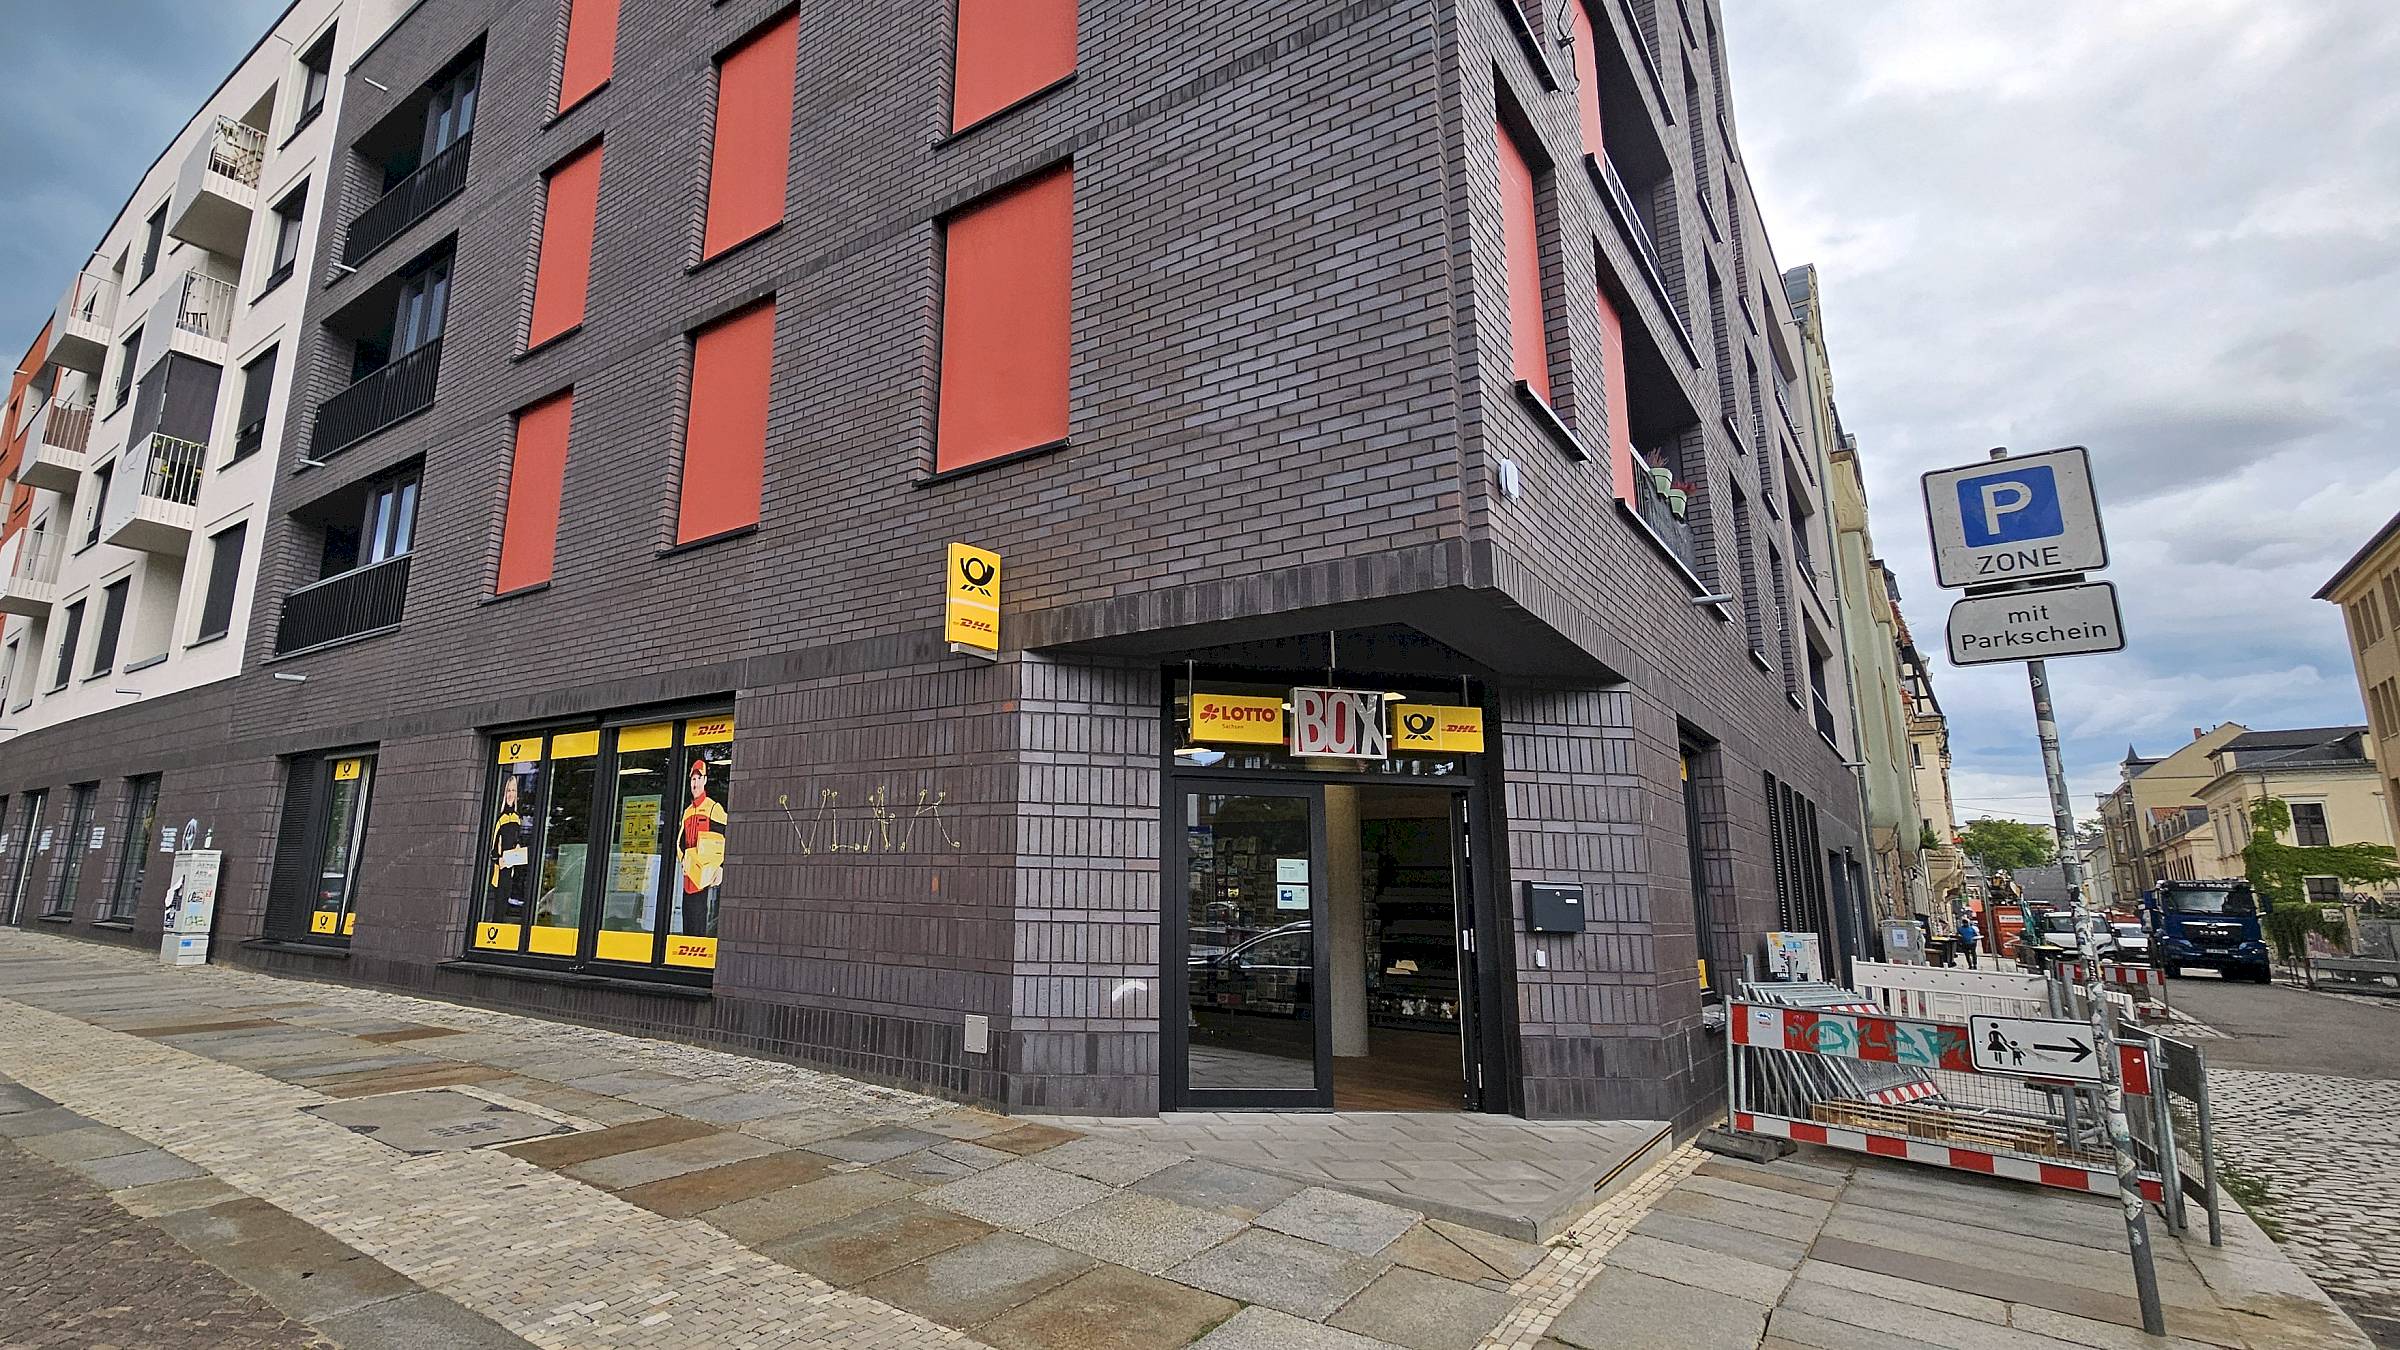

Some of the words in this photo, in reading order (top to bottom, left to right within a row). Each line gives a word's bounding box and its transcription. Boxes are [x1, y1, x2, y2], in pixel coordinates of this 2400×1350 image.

[1980, 481, 2033, 536] P
[1977, 546, 2062, 575] ZONE
[2008, 604, 2050, 624] mit
[959, 617, 993, 634] DHL
[1961, 621, 2108, 651] Parkschein
[1222, 706, 1275, 722] LOTTO
[1301, 691, 1385, 755] BOX
[698, 724, 726, 736] DHL
[1445, 724, 1478, 733] DHL
[679, 945, 708, 957] DHL
